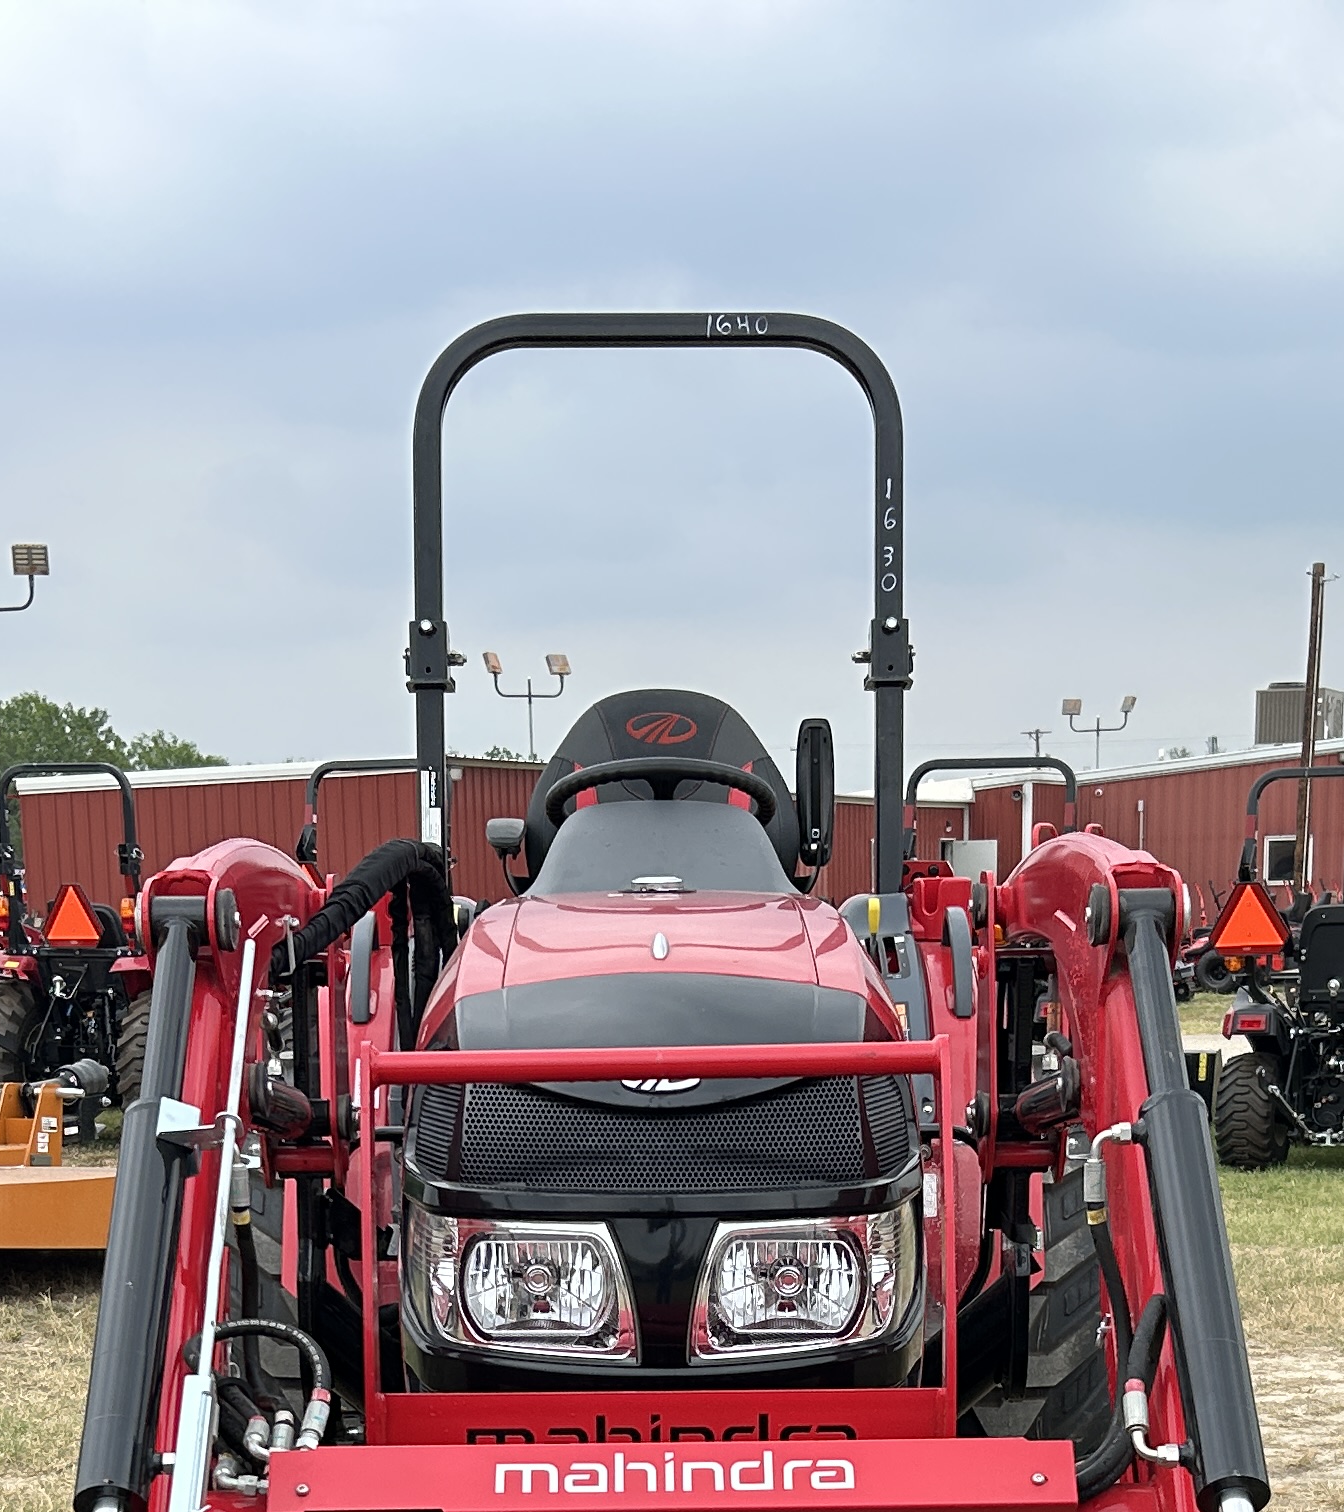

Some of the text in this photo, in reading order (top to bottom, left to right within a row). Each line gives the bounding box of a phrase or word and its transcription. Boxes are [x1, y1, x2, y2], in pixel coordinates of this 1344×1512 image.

[706, 314, 768, 338] 1640
[881, 477, 897, 592] 1630
[494, 1450, 856, 1494] mahindra
